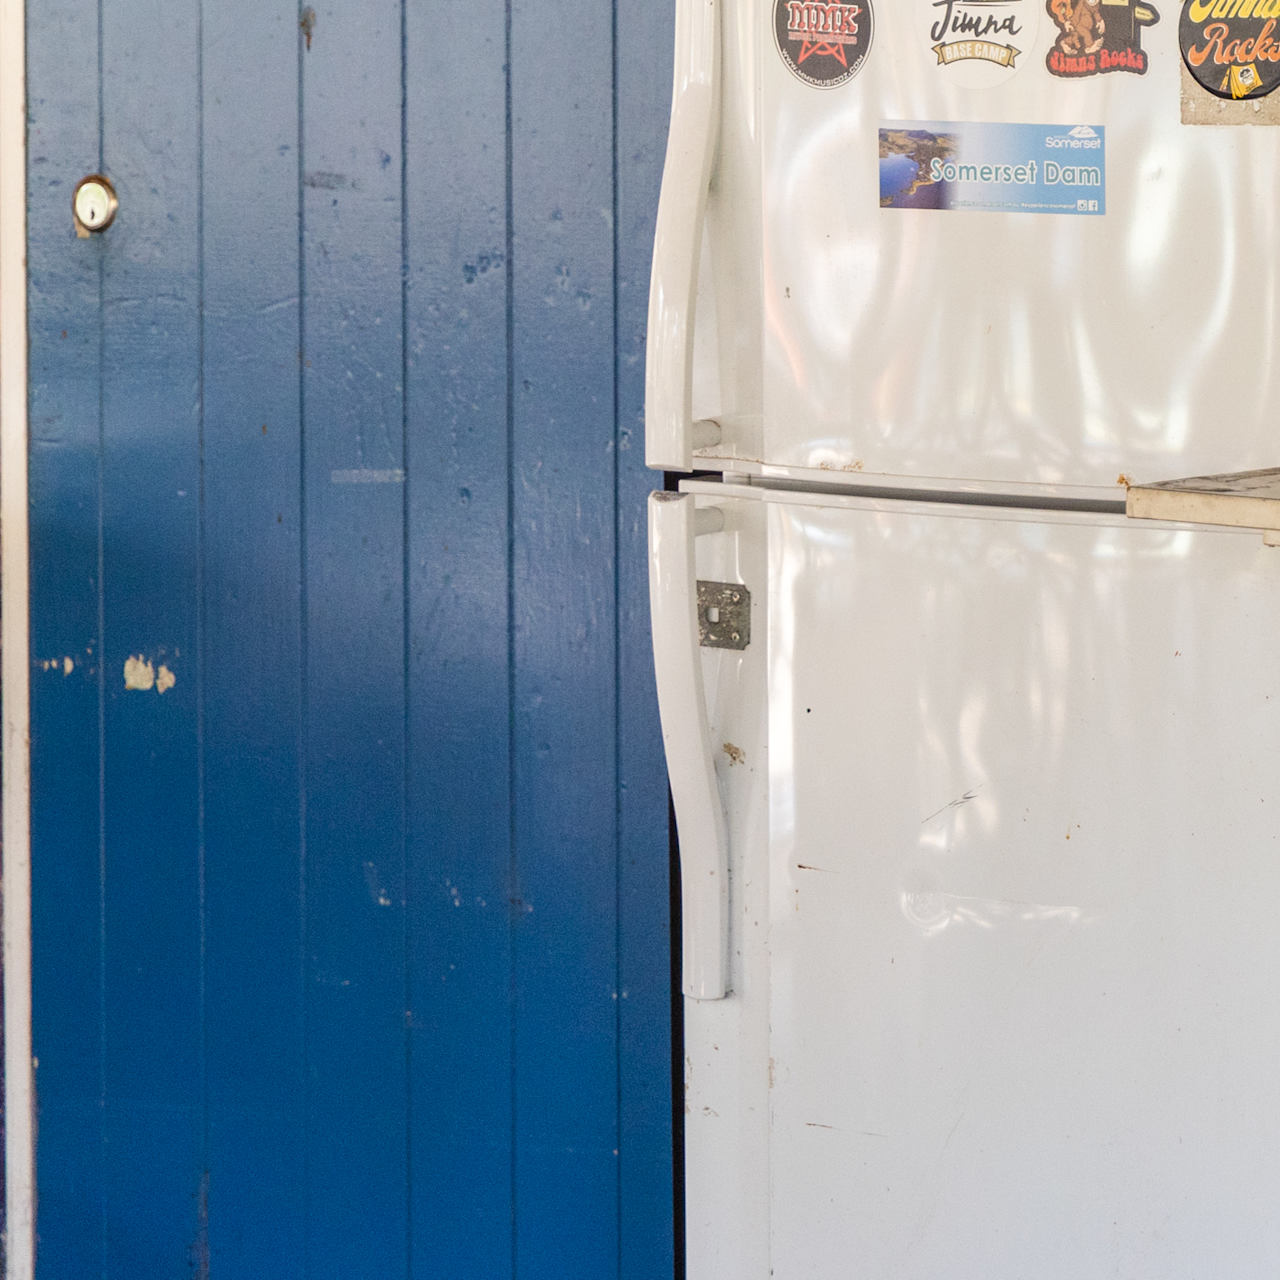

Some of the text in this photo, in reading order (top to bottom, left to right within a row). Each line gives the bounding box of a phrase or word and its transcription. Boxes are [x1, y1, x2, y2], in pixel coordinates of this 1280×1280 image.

[788, 1, 858, 34] MMK
[945, 43, 1007, 61] BASE CAMP
[1099, 47, 1144, 70] Rocks
[1045, 136, 1101, 149] Somerset
[930, 157, 1101, 186] Somerset Dam
